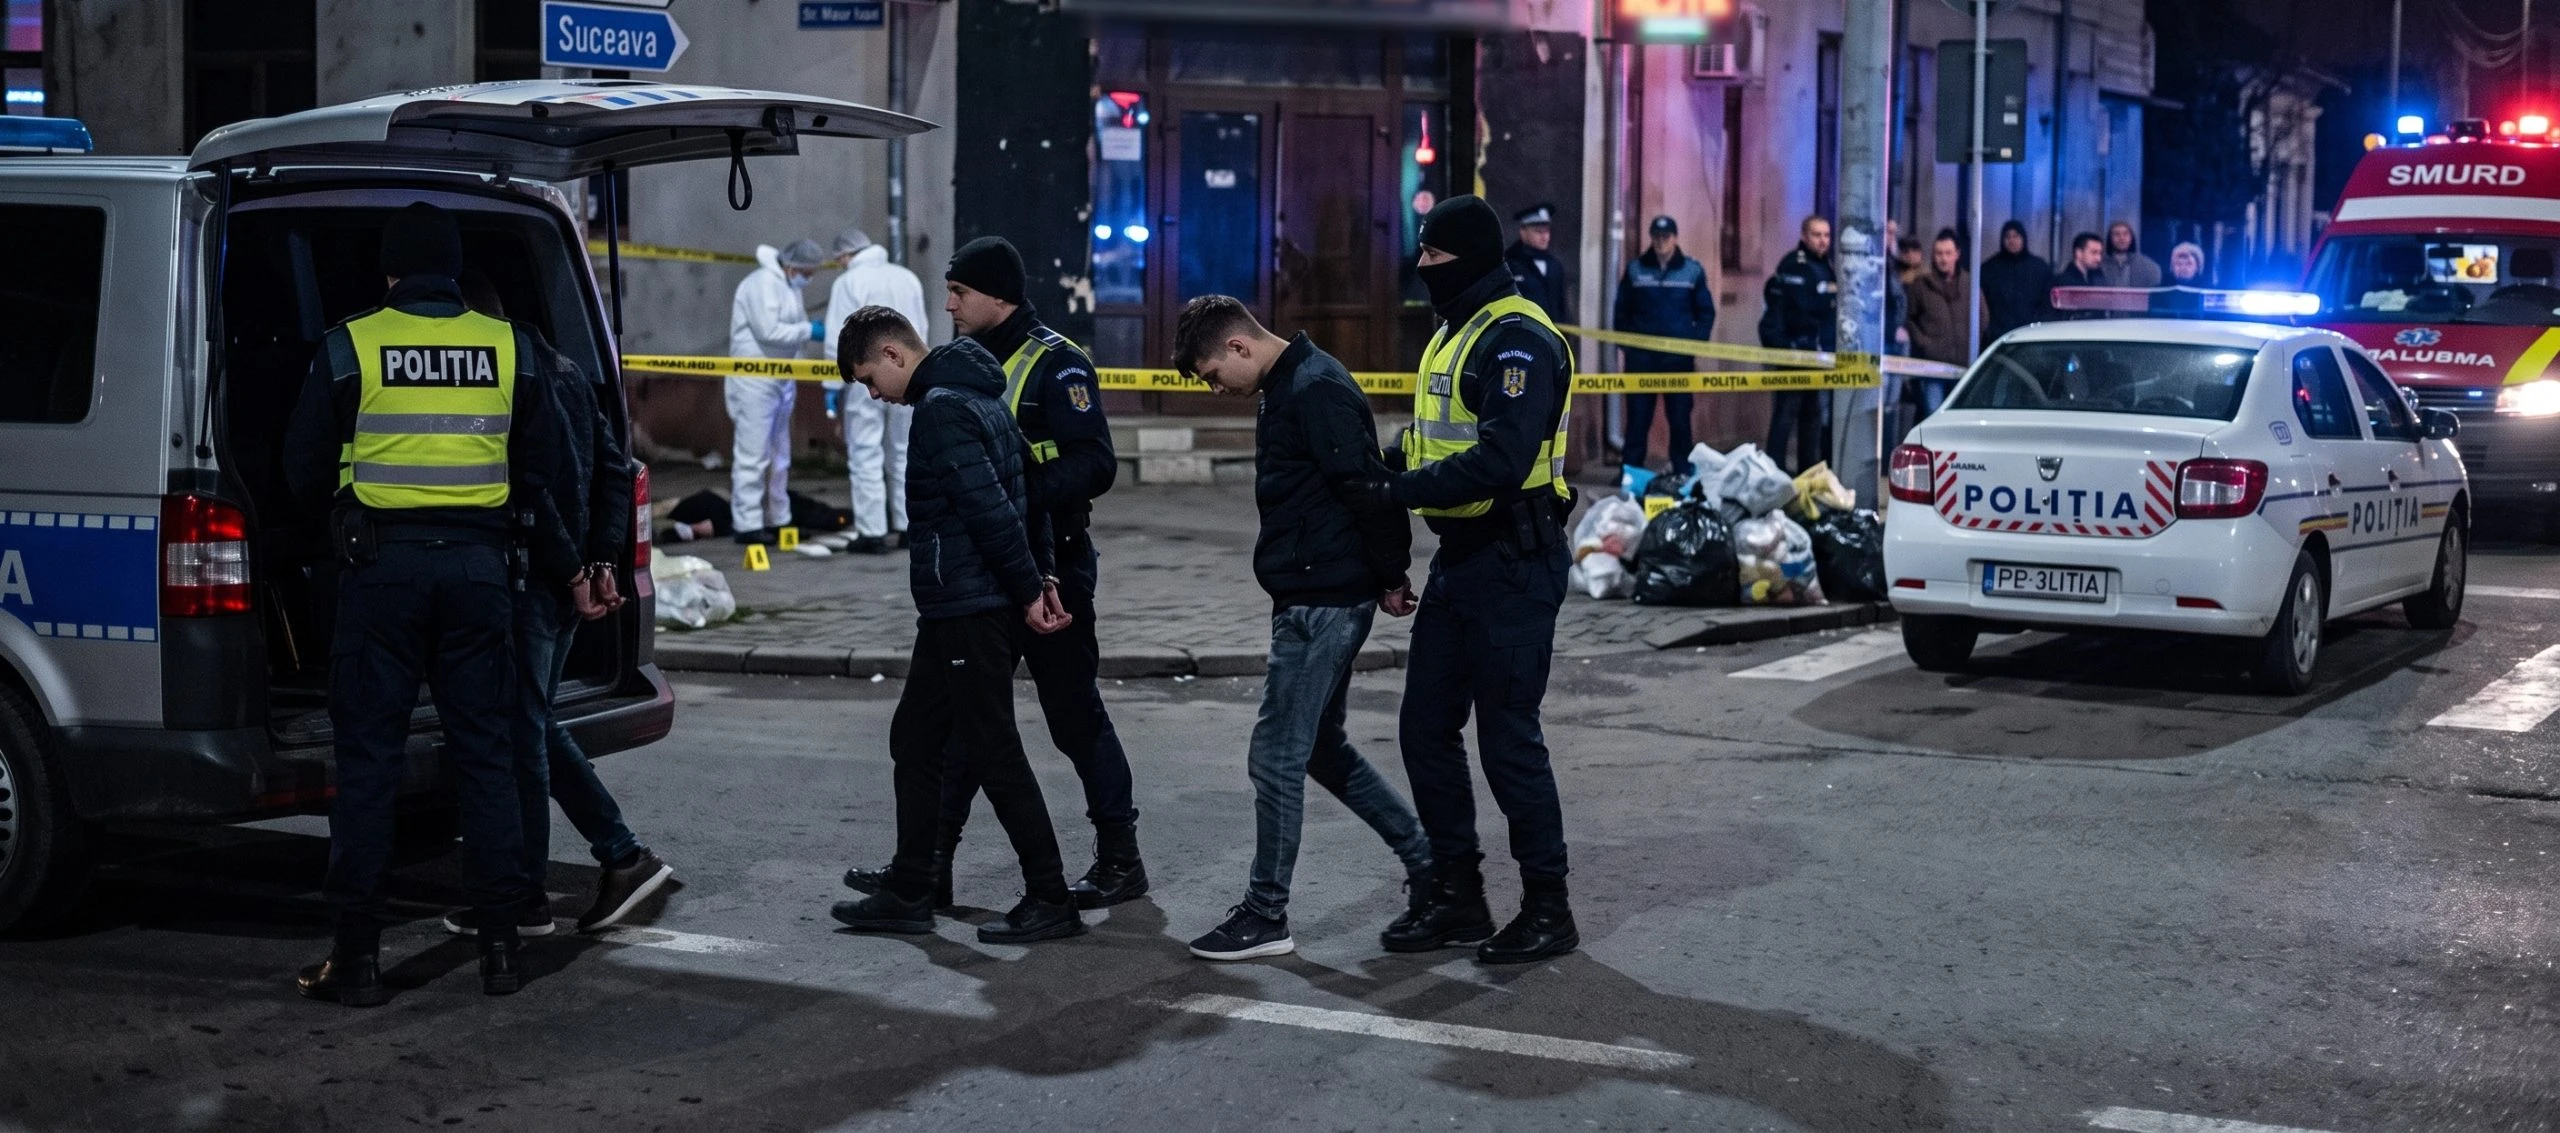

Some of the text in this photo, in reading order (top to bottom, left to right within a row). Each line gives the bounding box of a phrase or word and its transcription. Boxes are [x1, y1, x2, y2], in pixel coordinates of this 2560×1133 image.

[558, 15, 657, 58] Suceava
[2387, 164, 2526, 186] SMURD
[385, 349, 494, 387] POLIȚIA
[733, 361, 793, 376] POLIȚIA
[1578, 378, 1625, 391] POLIȚIA
[1702, 376, 1748, 390] POLIȚIA
[1823, 373, 1871, 389] POLIȚIA
[1964, 484, 2139, 523] POLIȚIA
[2352, 495, 2419, 537] POLIȚIA
